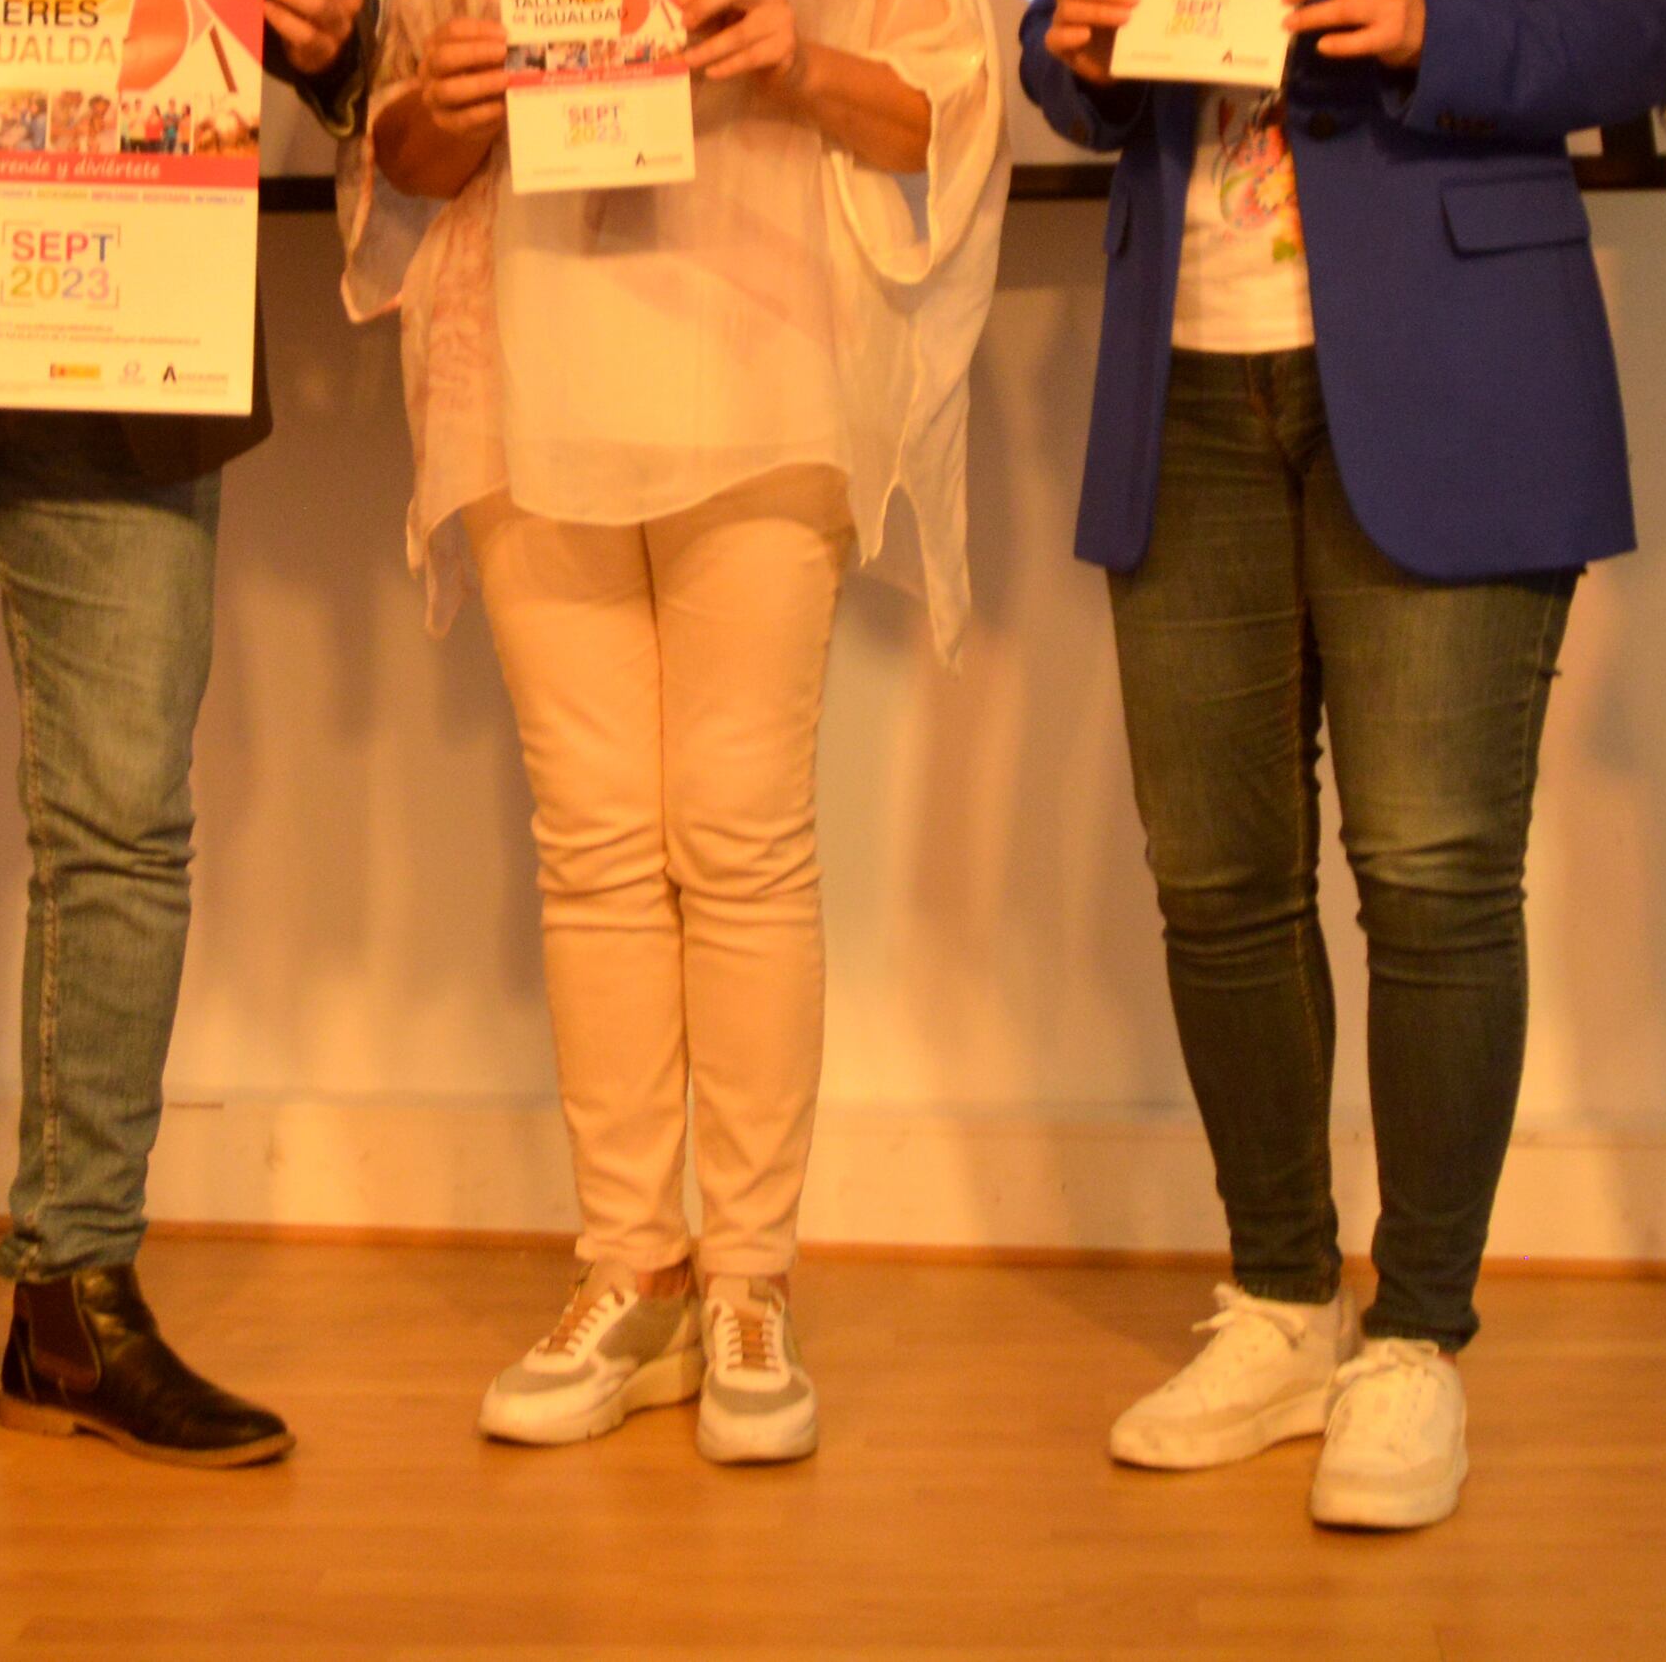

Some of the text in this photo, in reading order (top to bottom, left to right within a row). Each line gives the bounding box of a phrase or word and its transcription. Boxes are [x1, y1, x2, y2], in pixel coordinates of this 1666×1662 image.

[534, 7, 629, 28] IGUALDAD
[11, 230, 114, 264] SEPT
[10, 265, 110, 302] 2023
